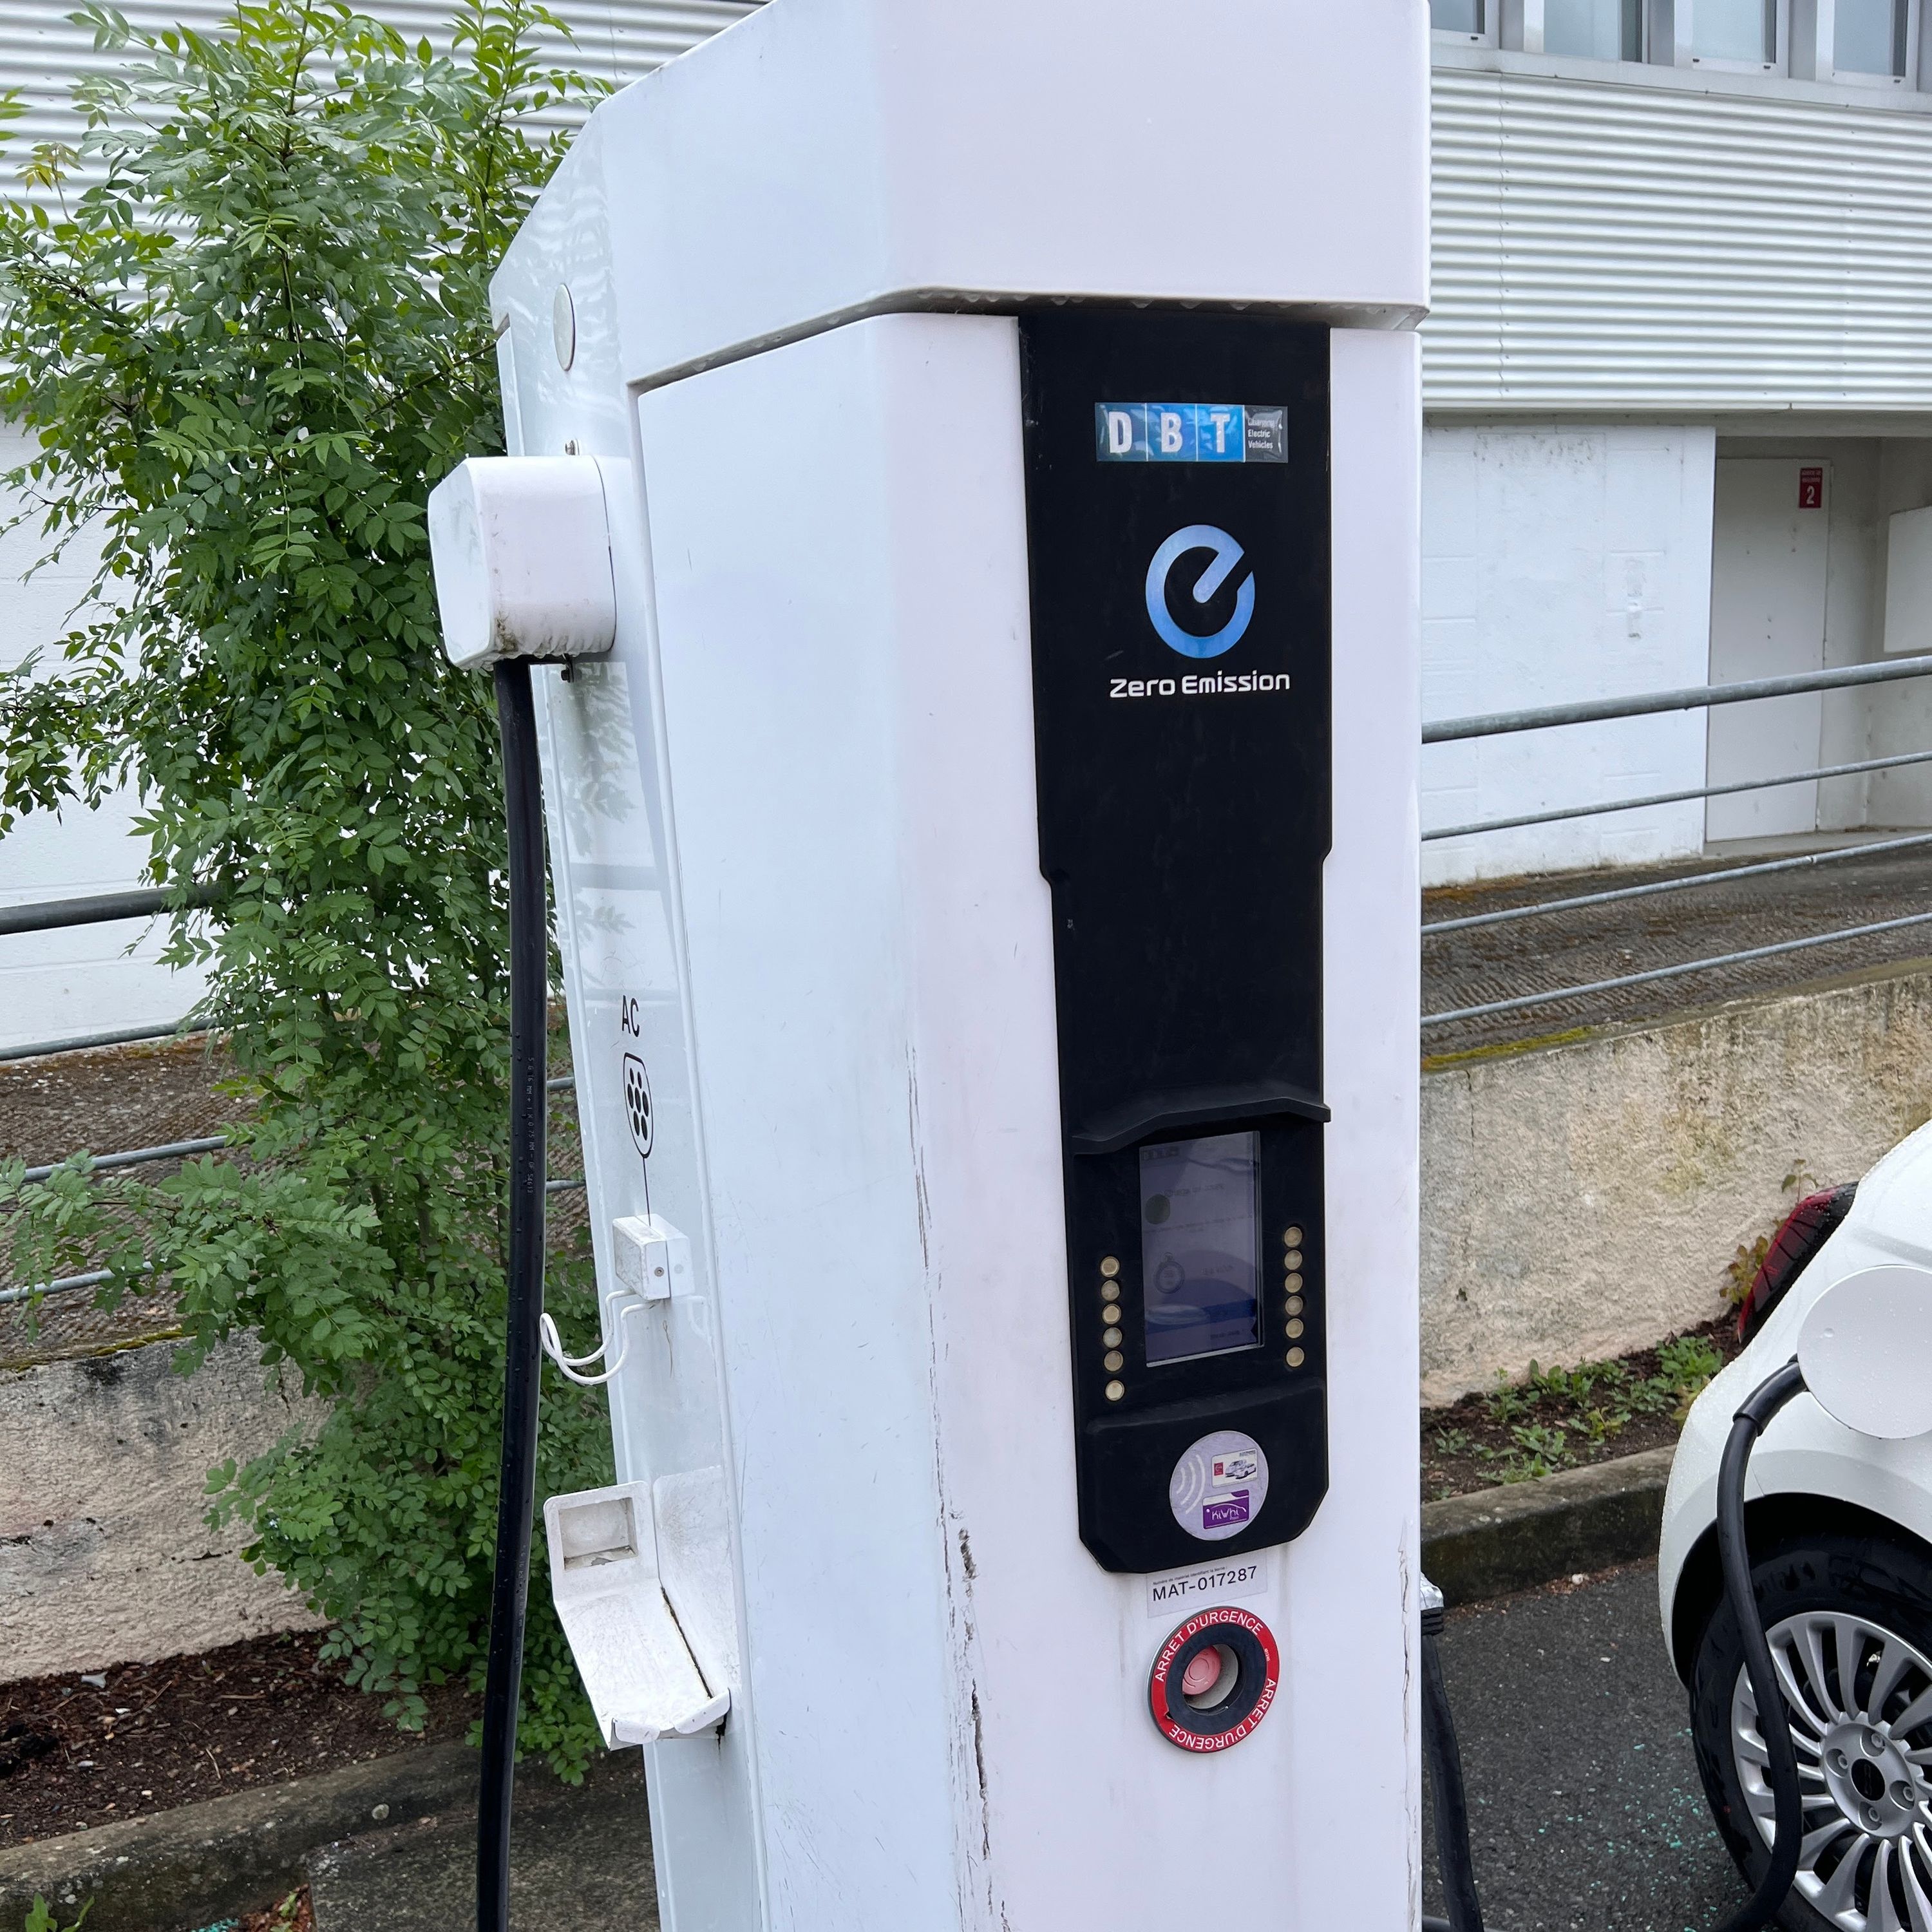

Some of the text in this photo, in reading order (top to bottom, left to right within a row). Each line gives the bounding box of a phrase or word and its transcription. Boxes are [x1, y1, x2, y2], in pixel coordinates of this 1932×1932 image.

[1247, 429, 1271, 438] Electric
[1247, 440, 1273, 449] Vehicles
[1806, 485, 1815, 504] 2
[1110, 670, 1291, 698] Zero Emission
[621, 994, 640, 1037] AC
[1153, 1566, 1257, 1601] MAT-017287
[1155, 1610, 1264, 1682] ARRET D'URGENCE
[1168, 1678, 1276, 1750] ARRET D'URGENCE
